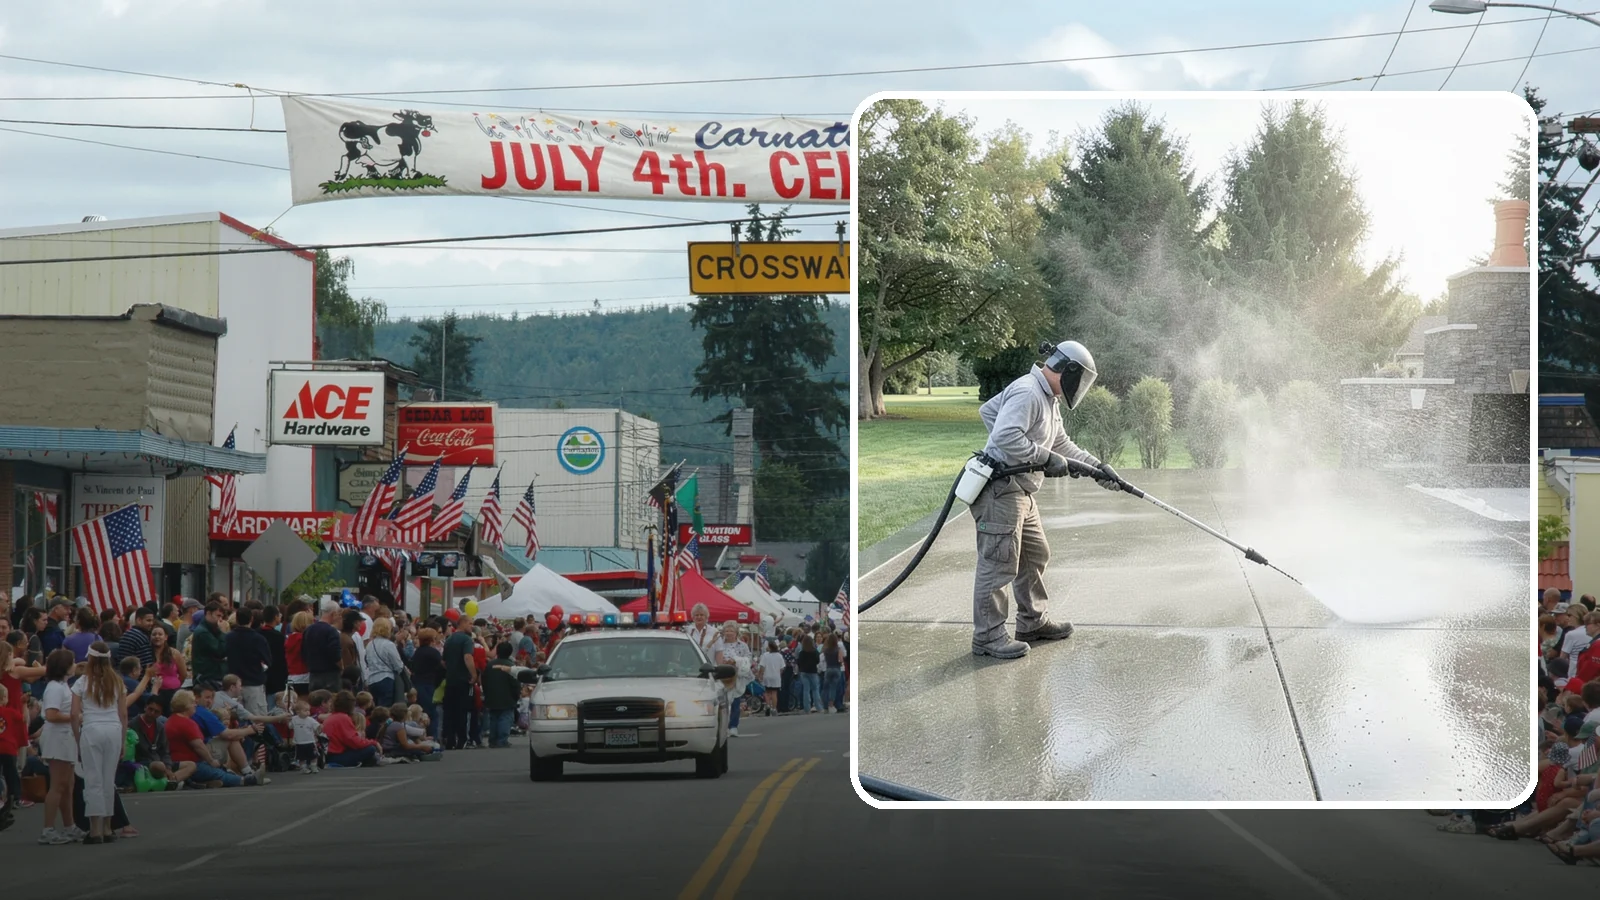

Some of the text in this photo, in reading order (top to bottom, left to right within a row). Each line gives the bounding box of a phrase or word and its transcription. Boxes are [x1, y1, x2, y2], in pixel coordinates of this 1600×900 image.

[695, 121, 850, 150] Carnat
[481, 141, 604, 192] JULY
[632, 149, 746, 198] 4th.
[697, 254, 850, 280] CROSSWA
[282, 380, 374, 420] ACE
[283, 421, 370, 436] Hardware
[416, 428, 477, 447] Coca-Cola
[353, 467, 390, 483] Simpl
[96, 485, 124, 495] Vincent
[126, 486, 136, 495] de
[138, 486, 155, 495] Paul
[213, 515, 330, 535] HARDARE
[688, 526, 741, 535] CRNATION
[699, 535, 730, 543] GLASS
